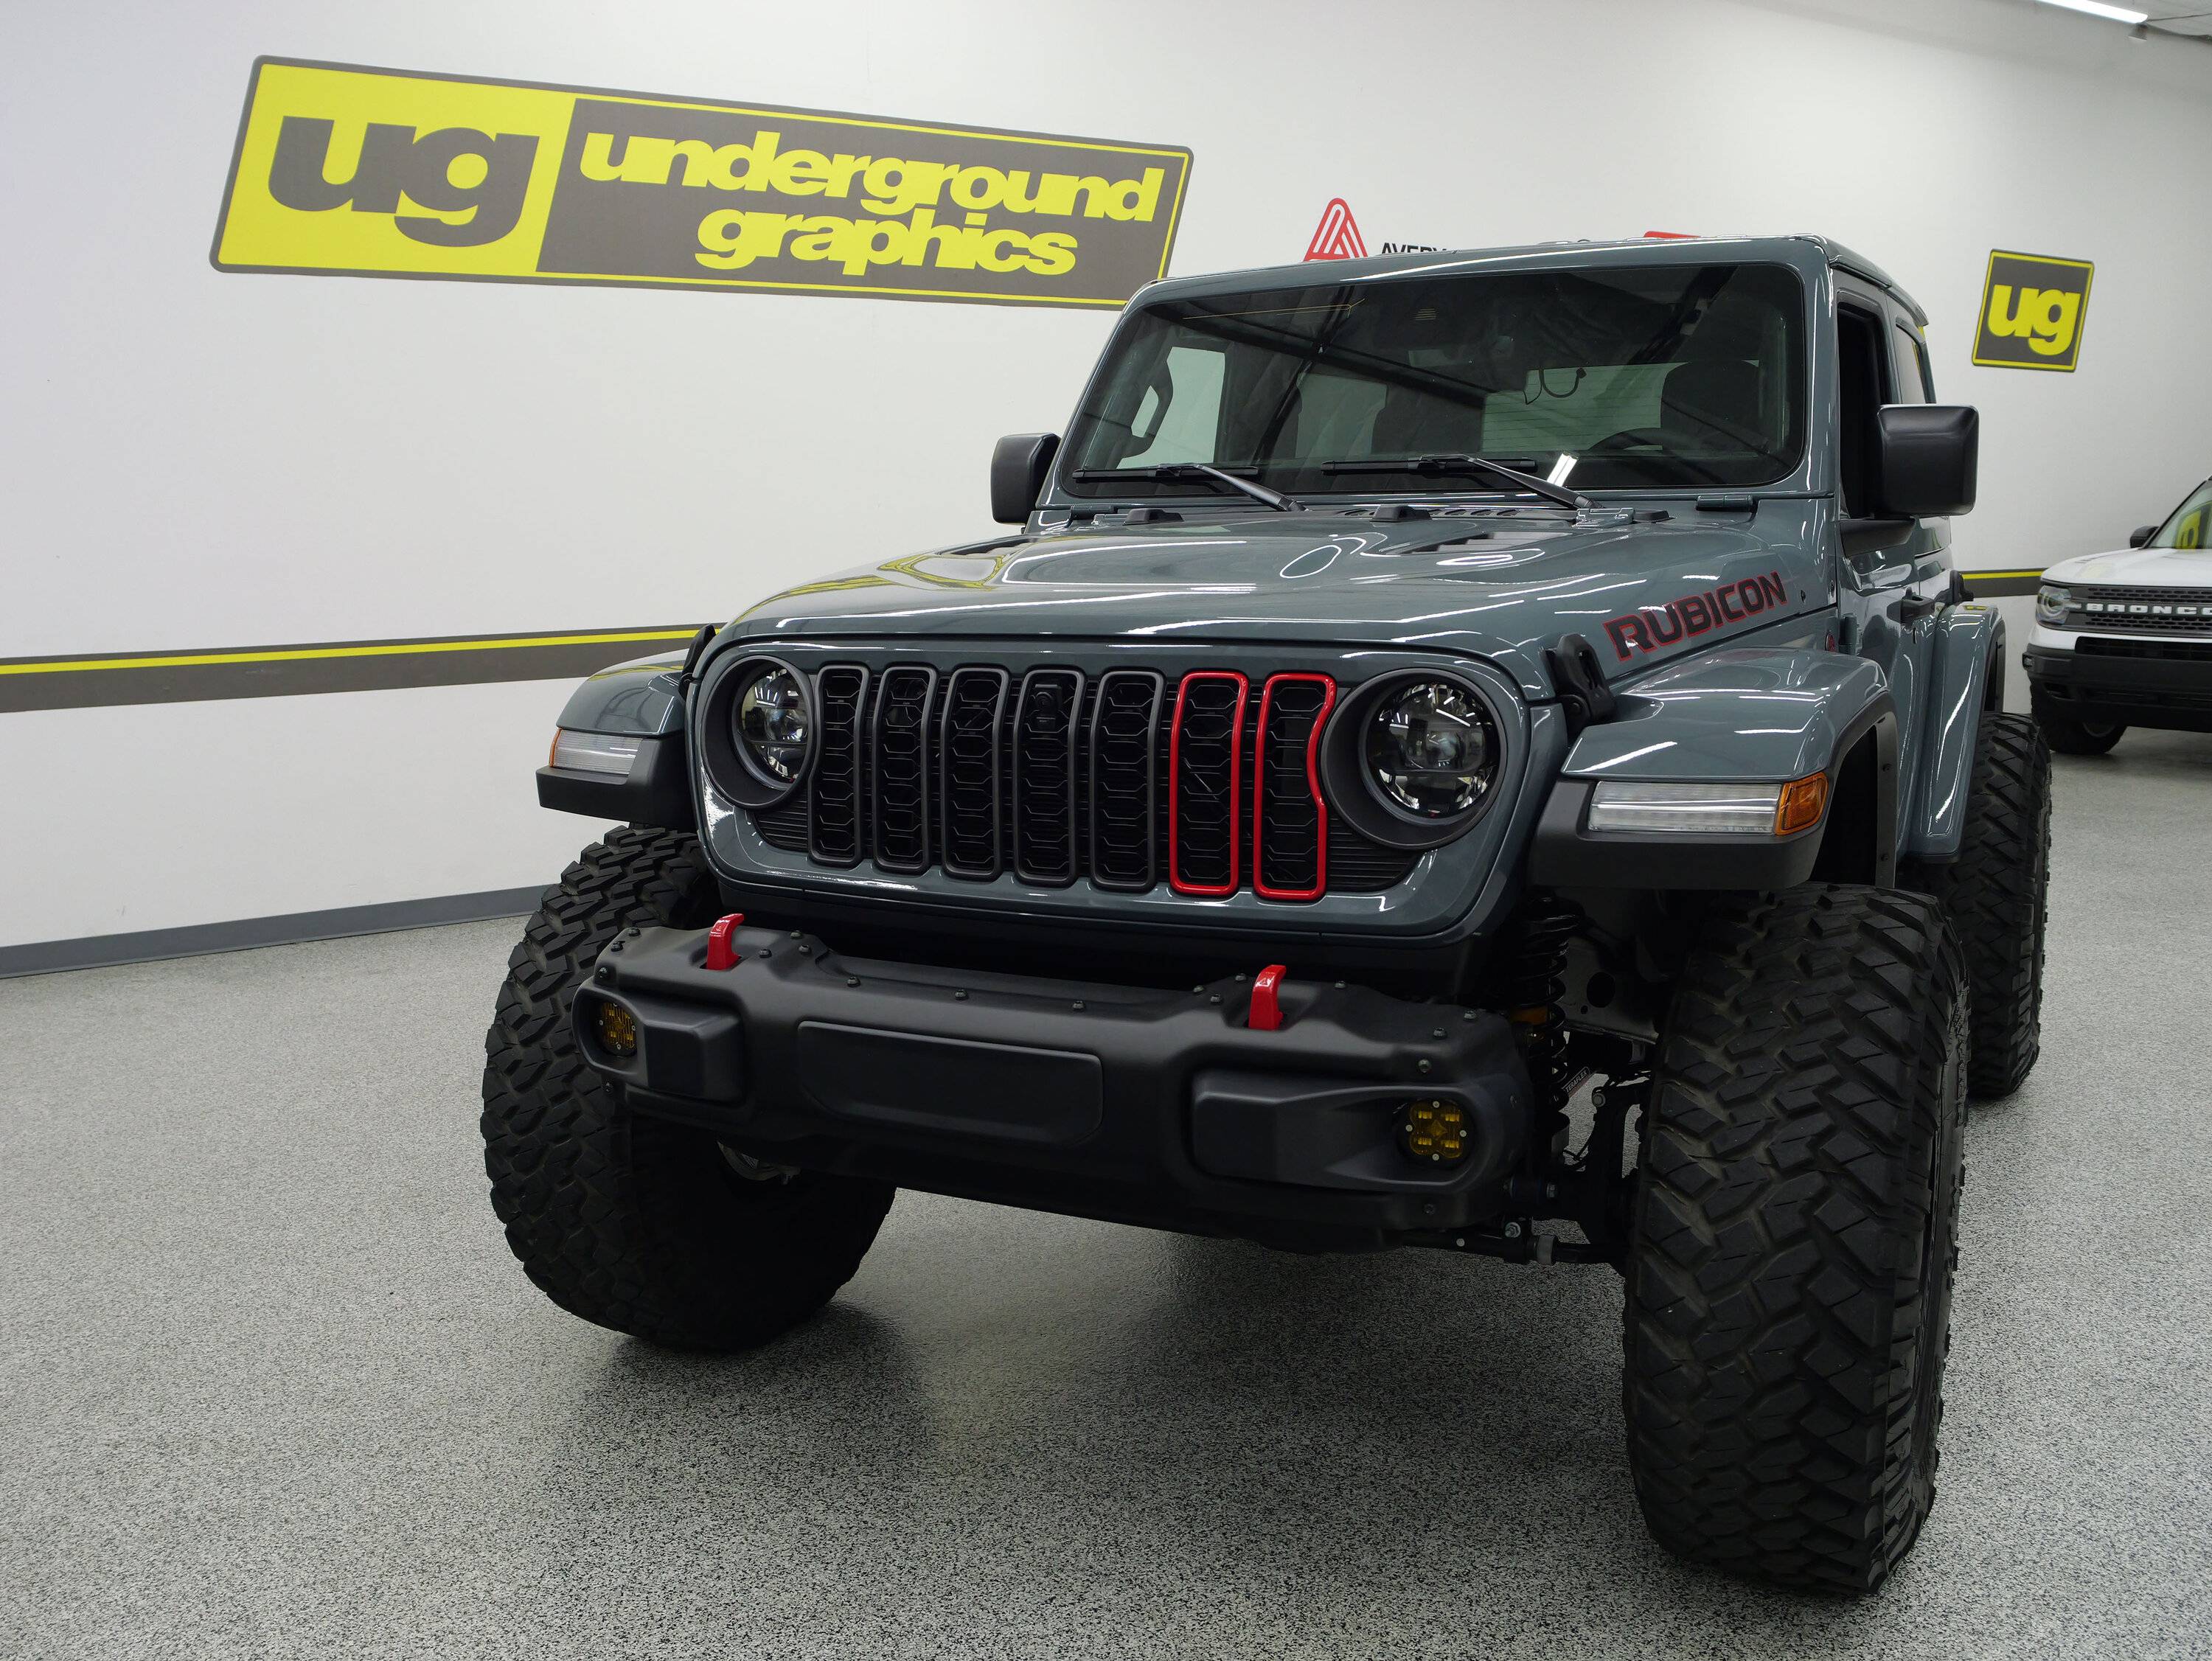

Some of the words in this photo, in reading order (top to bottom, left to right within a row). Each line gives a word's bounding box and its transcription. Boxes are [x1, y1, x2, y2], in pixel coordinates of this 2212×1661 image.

[268, 115, 540, 248] ug
[580, 130, 1164, 221] underground
[695, 208, 1077, 276] graphics
[1987, 284, 2081, 356] ug
[1604, 571, 1788, 662] RUBICON
[1565, 1070, 1587, 1093] TERAFLEX
